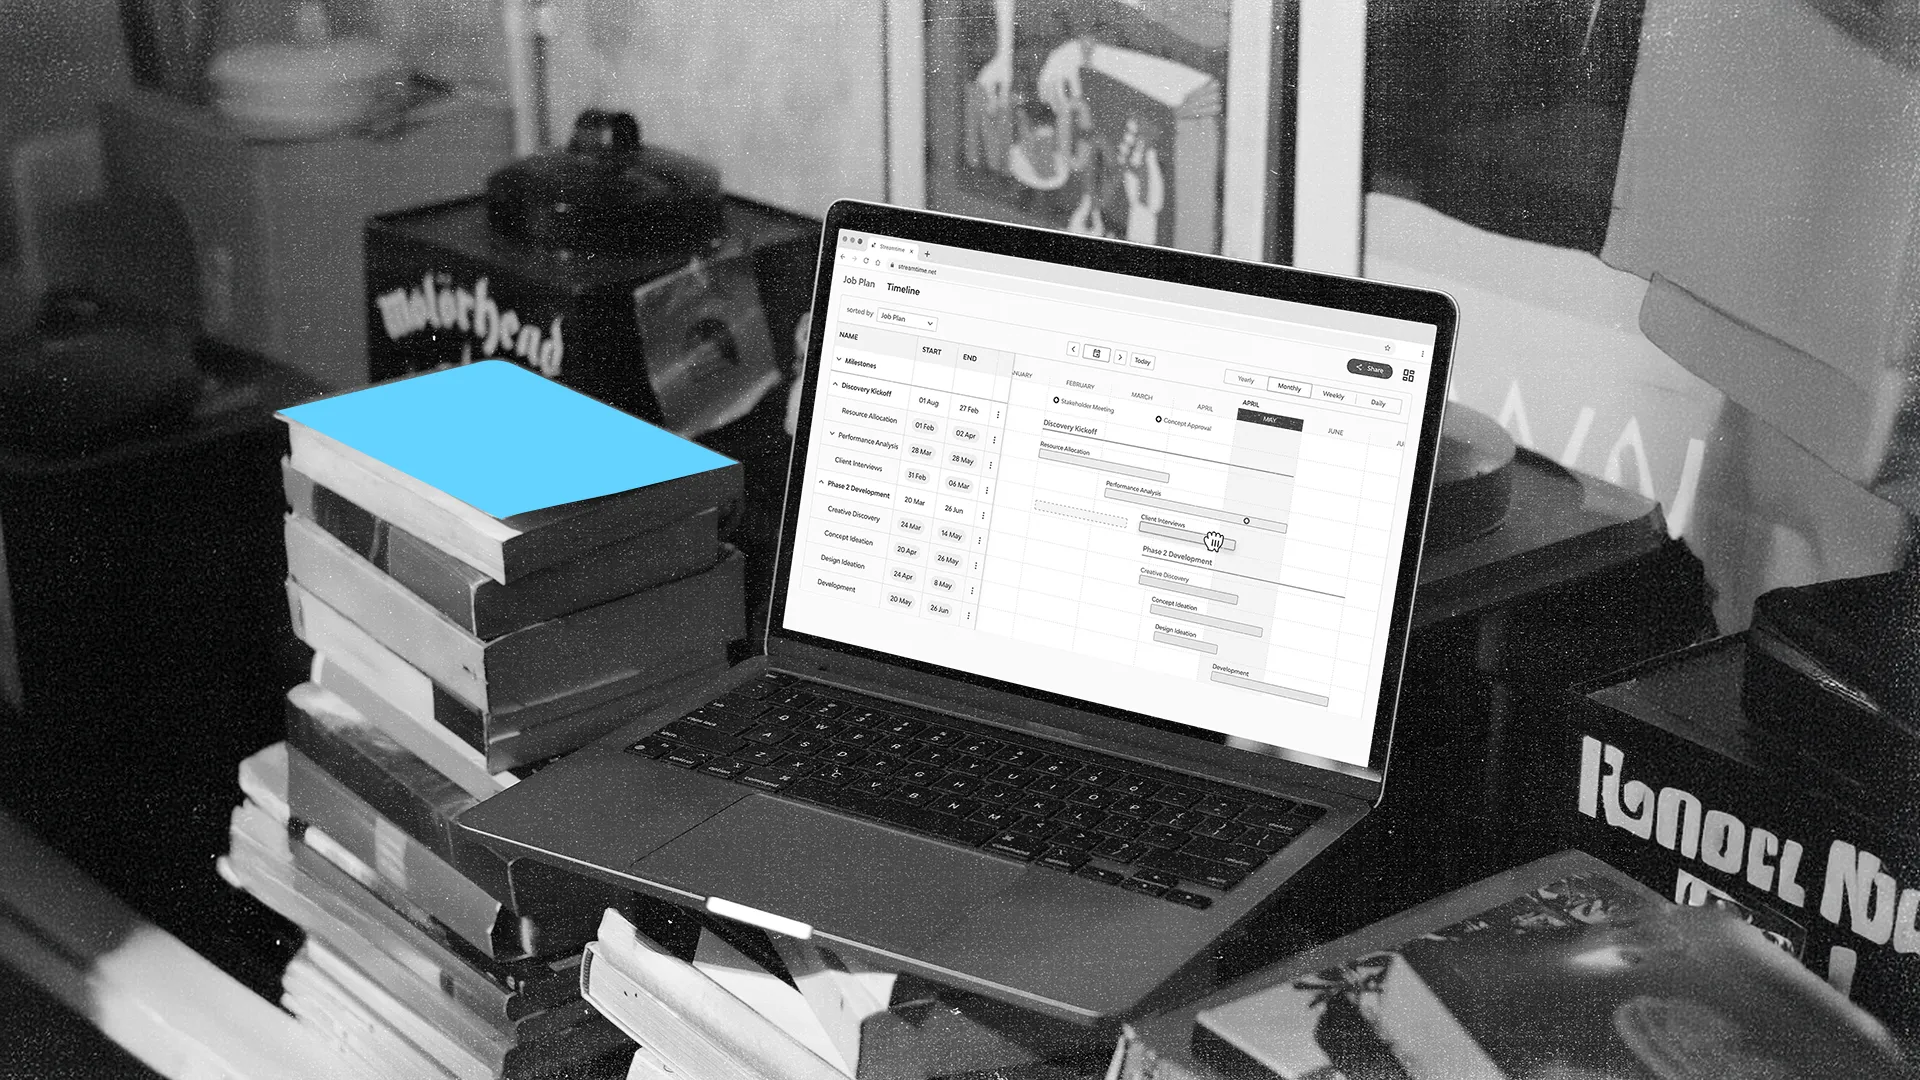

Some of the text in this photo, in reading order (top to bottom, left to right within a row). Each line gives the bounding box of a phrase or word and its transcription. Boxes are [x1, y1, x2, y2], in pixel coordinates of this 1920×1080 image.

[880, 243, 905, 253] Streamtime
[898, 263, 937, 275] streamtime.net
[843, 275, 876, 288] Job Plan
[887, 283, 920, 296] Timeline
[846, 306, 874, 318] sorted by
[880, 312, 906, 323] Job Plan
[839, 331, 858, 340] NAME
[922, 346, 942, 355] START
[963, 354, 977, 362] END
[1134, 357, 1151, 366] Today
[844, 357, 877, 370] Milestones
[1367, 365, 1384, 374] Share
[1066, 379, 1095, 390] FEBRUARY
[1237, 375, 1255, 385] Yearly
[841, 382, 892, 397] Discovery Kickoff
[1277, 382, 1302, 393] Monthly
[1131, 392, 1153, 400] MARCH
[1322, 390, 1345, 401] Weekly
[927, 398, 940, 408] Aug
[1061, 398, 1115, 414] Stakeholder Meeting
[1197, 404, 1213, 412] APRIL
[1242, 399, 1260, 408] APRIL
[1370, 398, 1386, 408] Daily
[959, 404, 980, 414] 27 Feb
[842, 407, 898, 424] Resource Allocation
[923, 423, 935, 432] Feb
[1043, 420, 1098, 436] Discovery Kickoff
[1163, 417, 1212, 432] Concept Approval
[965, 431, 976, 440] Apr
[1328, 427, 1344, 436] JUNE
[838, 432, 899, 450] Performance Analysis
[920, 448, 932, 456] Mar
[1040, 441, 1090, 456] Resource Allocation
[834, 456, 883, 472] Client Interviews
[960, 456, 974, 466] May
[916, 473, 927, 481] Feb
[827, 480, 845, 490] Phase
[850, 484, 890, 499] Development
[958, 482, 970, 490] Mar
[1106, 480, 1161, 497] Performance Analysis
[913, 498, 925, 506] Mar
[827, 505, 880, 523] Creative Discovery
[953, 506, 964, 514] Jun
[1141, 514, 1186, 528] Client Interviews
[909, 523, 922, 531] Mar
[824, 530, 874, 546] Concept Ideation
[949, 531, 962, 540] May
[906, 548, 917, 556] Apr
[1142, 545, 1162, 556] Phase
[1168, 551, 1212, 566] Development
[820, 554, 865, 570] Design Ideation
[946, 556, 959, 566] May
[902, 572, 913, 581] Apr
[1140, 567, 1190, 583] Creative Discovery
[817, 579, 856, 593] Development
[939, 581, 952, 590] May
[899, 597, 912, 607] May
[1151, 596, 1198, 611] Concept Ideation
[938, 606, 949, 614] Jun
[1154, 624, 1197, 638] Design Ideation
[1212, 663, 1249, 677] Development
[669, 756, 694, 764] control
[708, 766, 730, 774] option
[744, 776, 780, 788] command
